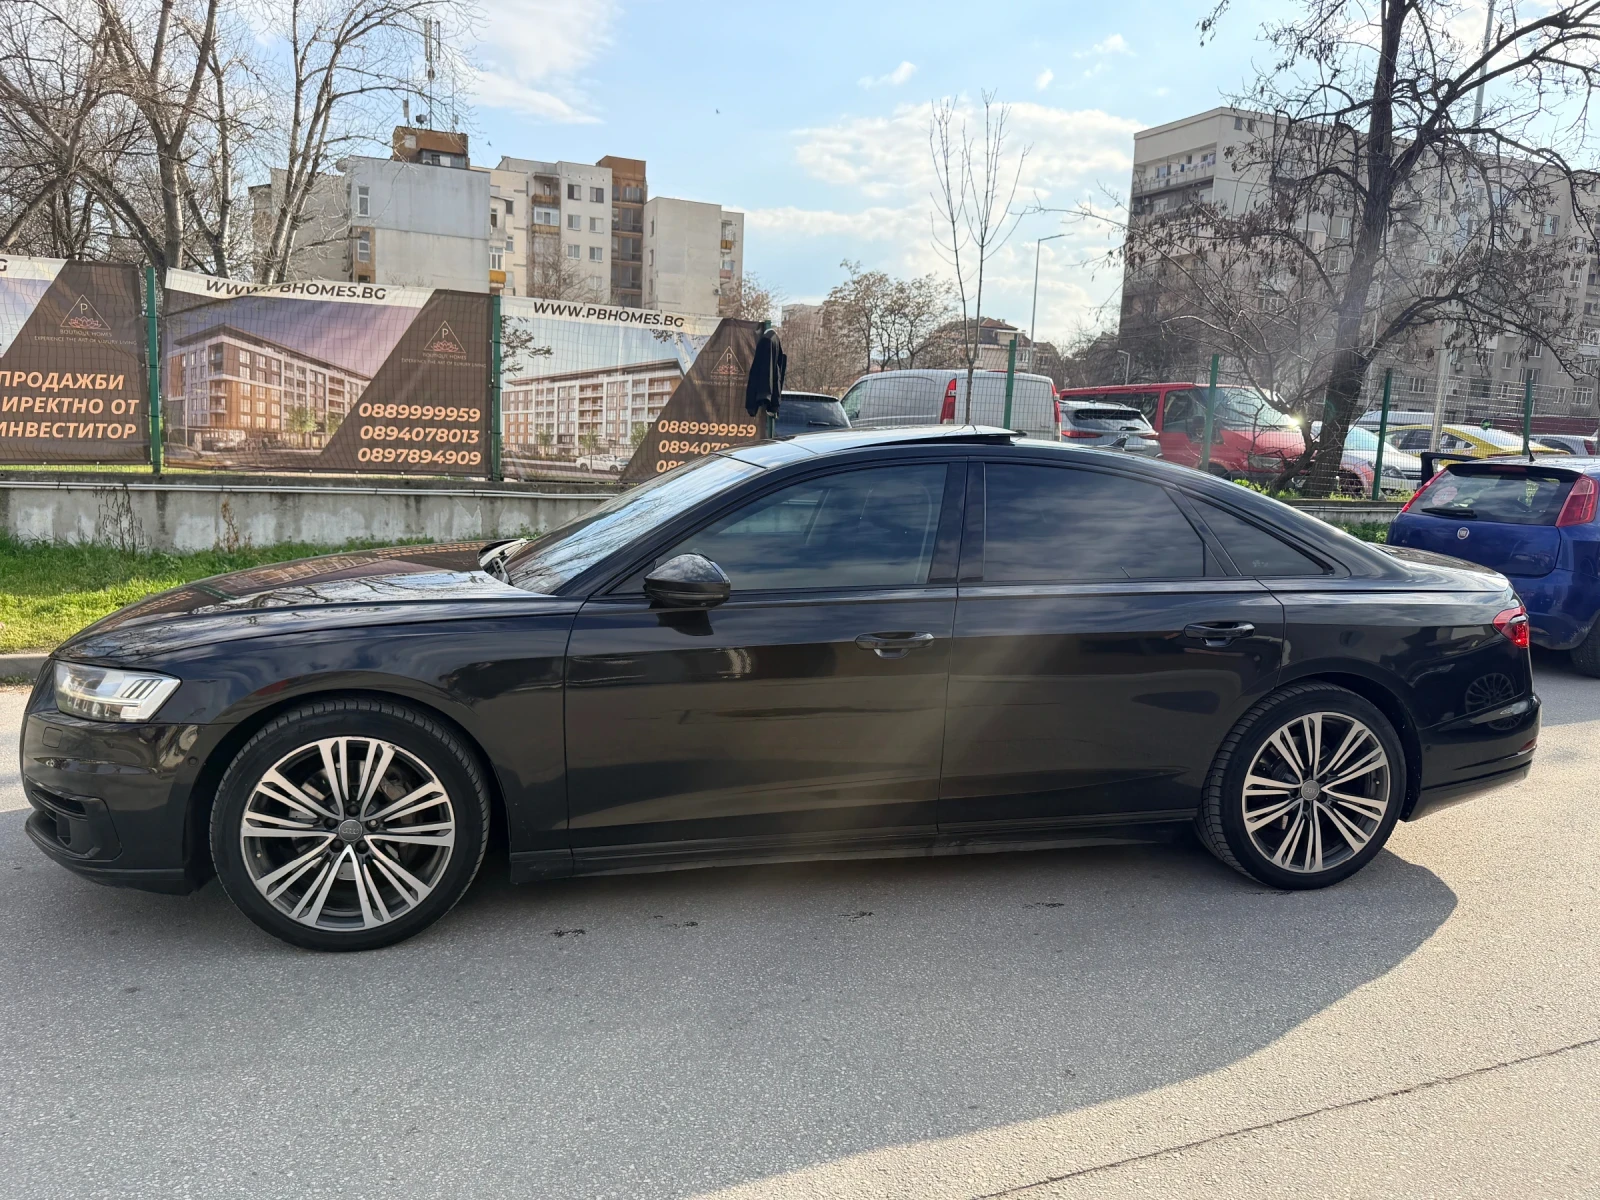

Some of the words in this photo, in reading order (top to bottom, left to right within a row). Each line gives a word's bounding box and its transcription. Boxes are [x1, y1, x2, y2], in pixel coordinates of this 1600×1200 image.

[80, 303, 88, 314] P
[533, 301, 685, 328] WWW.PBHOMES.BG
[60, 329, 89, 337] BOUTIQUE
[442, 328, 449, 339] P
[726, 353, 733, 362] P
[0, 370, 125, 392] ПРОДАЖБИ
[2, 396, 104, 414] ИРЕКТНО
[111, 399, 140, 415] ОТ
[358, 402, 481, 422] 0889999959
[360, 425, 480, 444] 0894078013
[657, 419, 757, 437] 0889999959
[357, 447, 482, 465] 0897894909
[658, 440, 737, 455] 089407
